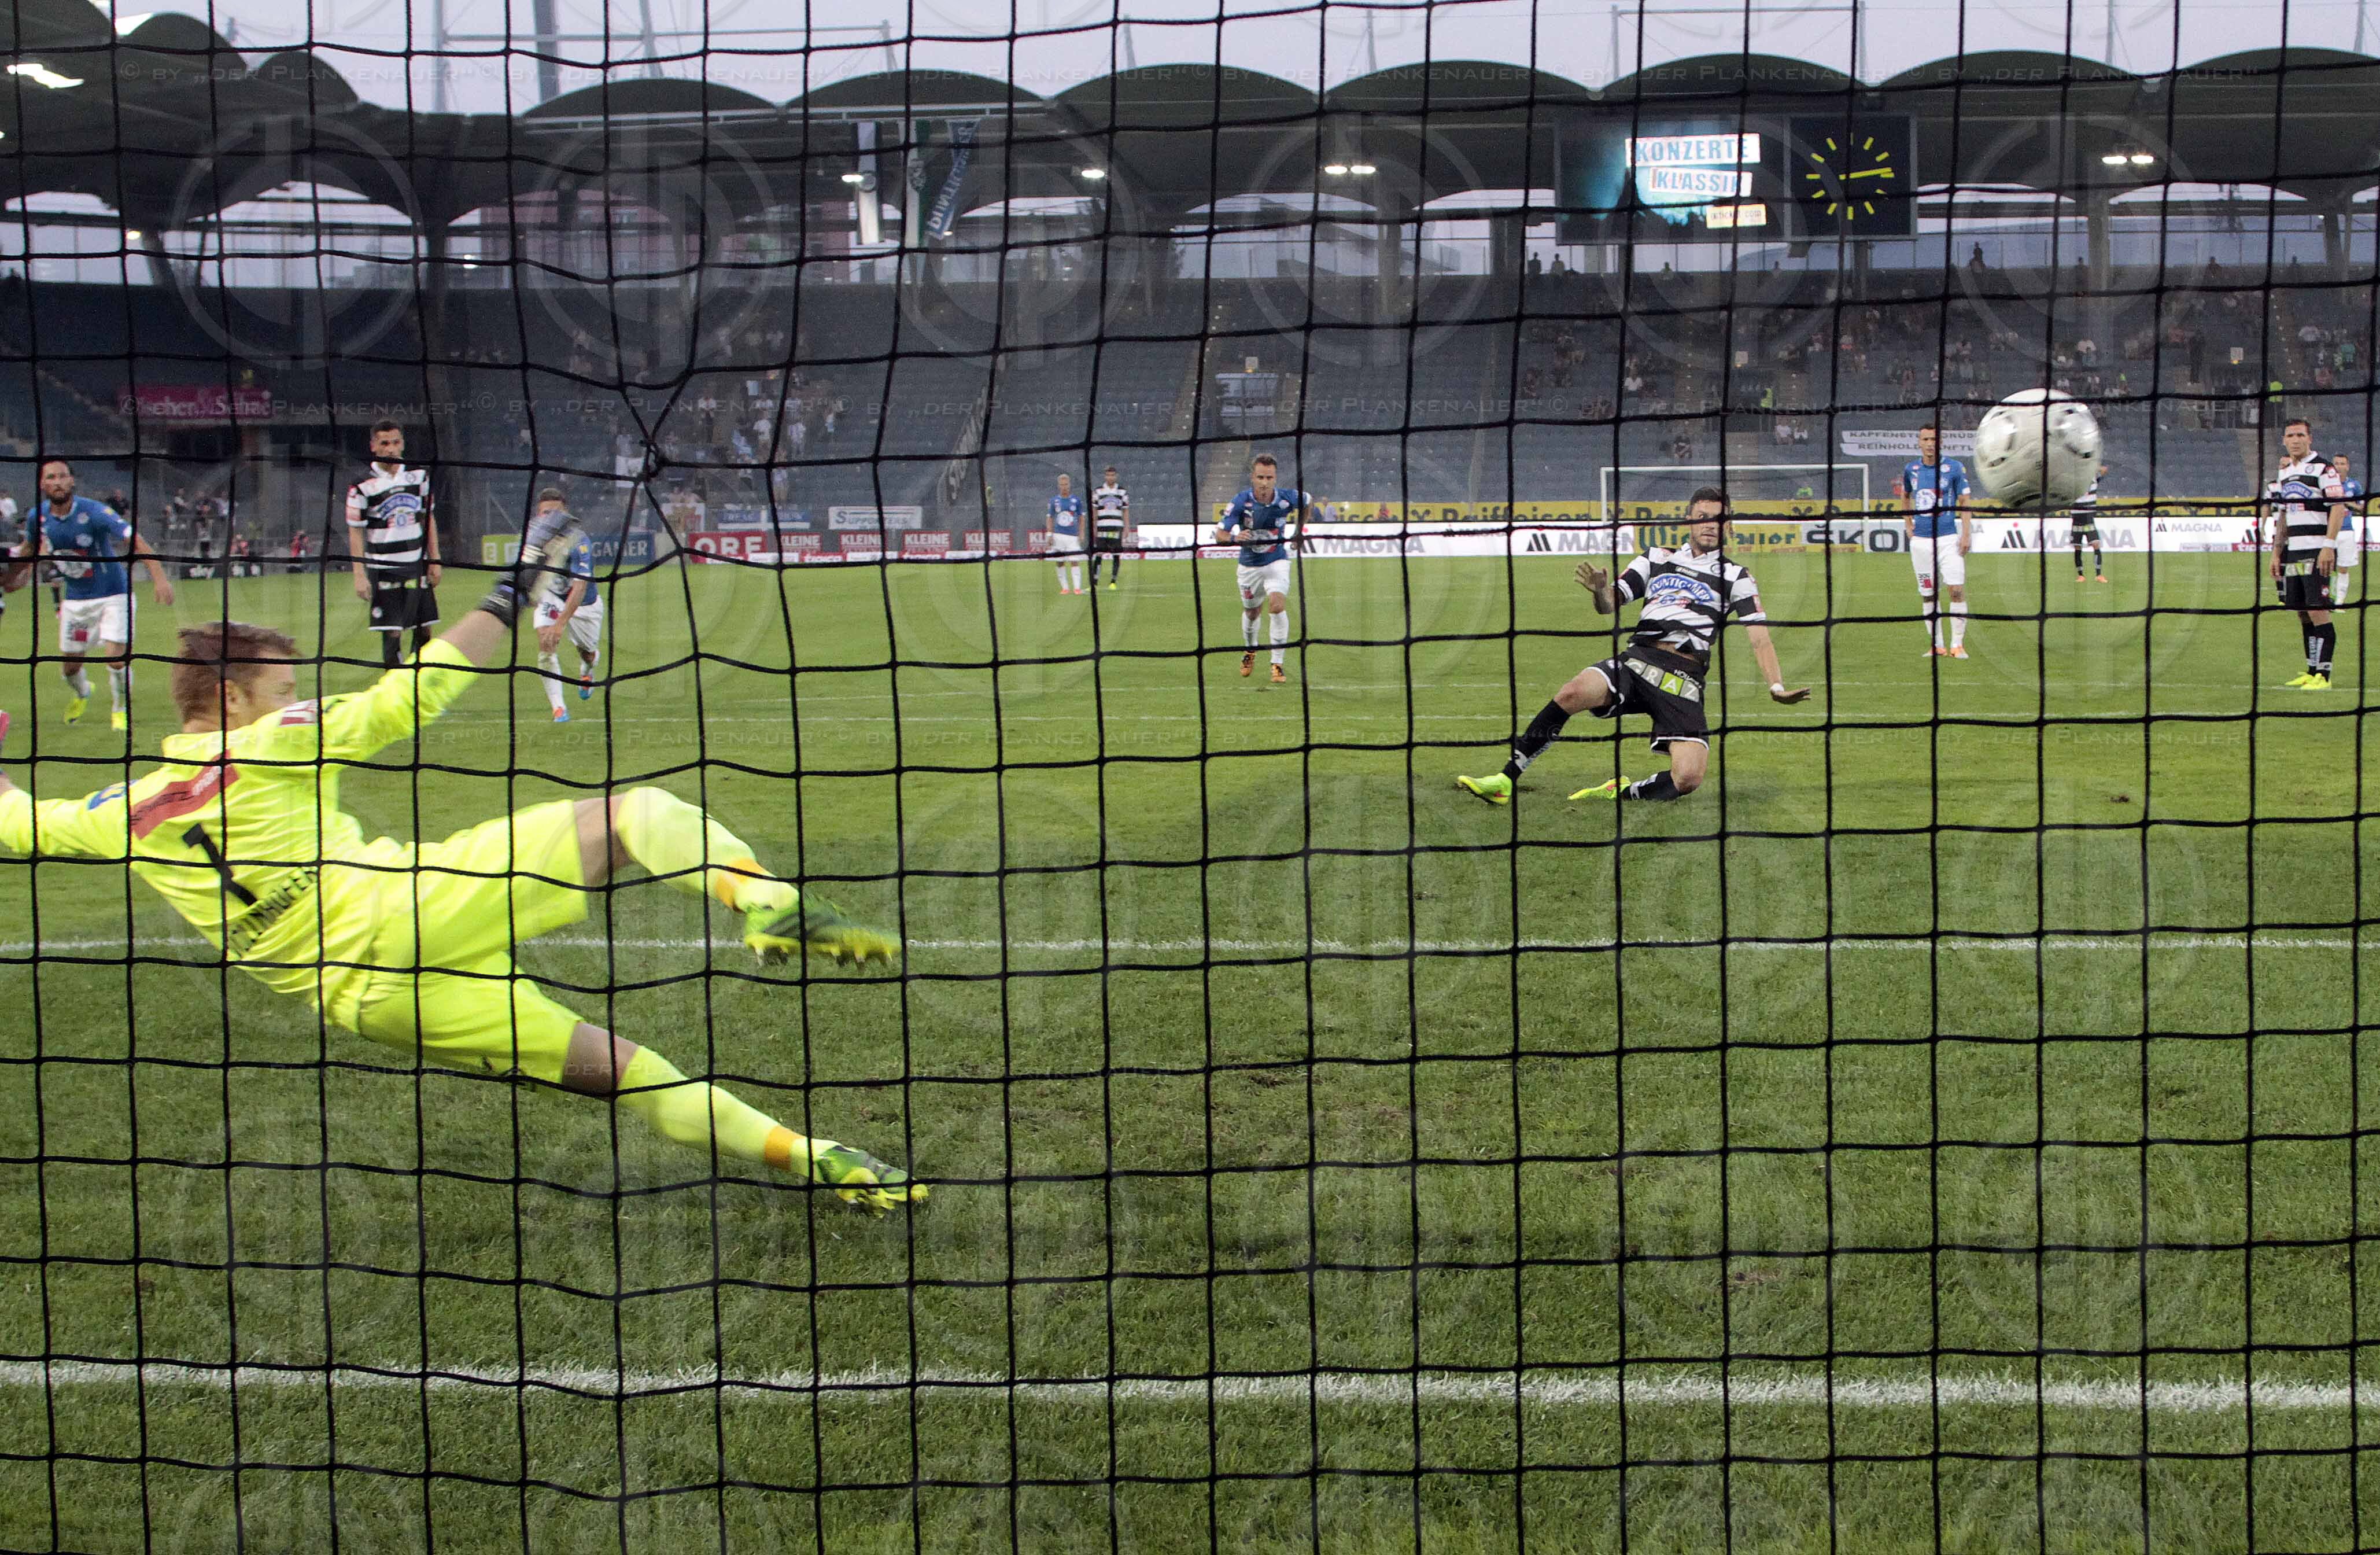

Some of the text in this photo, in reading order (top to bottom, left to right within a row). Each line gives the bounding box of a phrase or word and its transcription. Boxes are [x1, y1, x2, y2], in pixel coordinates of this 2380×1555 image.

[1636, 138, 1749, 161] KONZERTE
[1806, 524, 1909, 552] ŠKO
[2171, 524, 2223, 532] MAGNA
[966, 533, 1010, 544] KLNE
[1323, 538, 1425, 554] MAGNA
[2032, 530, 2137, 548] MANA
[1628, 659, 1699, 701] GRAZ
[182, 824, 259, 907] 1
